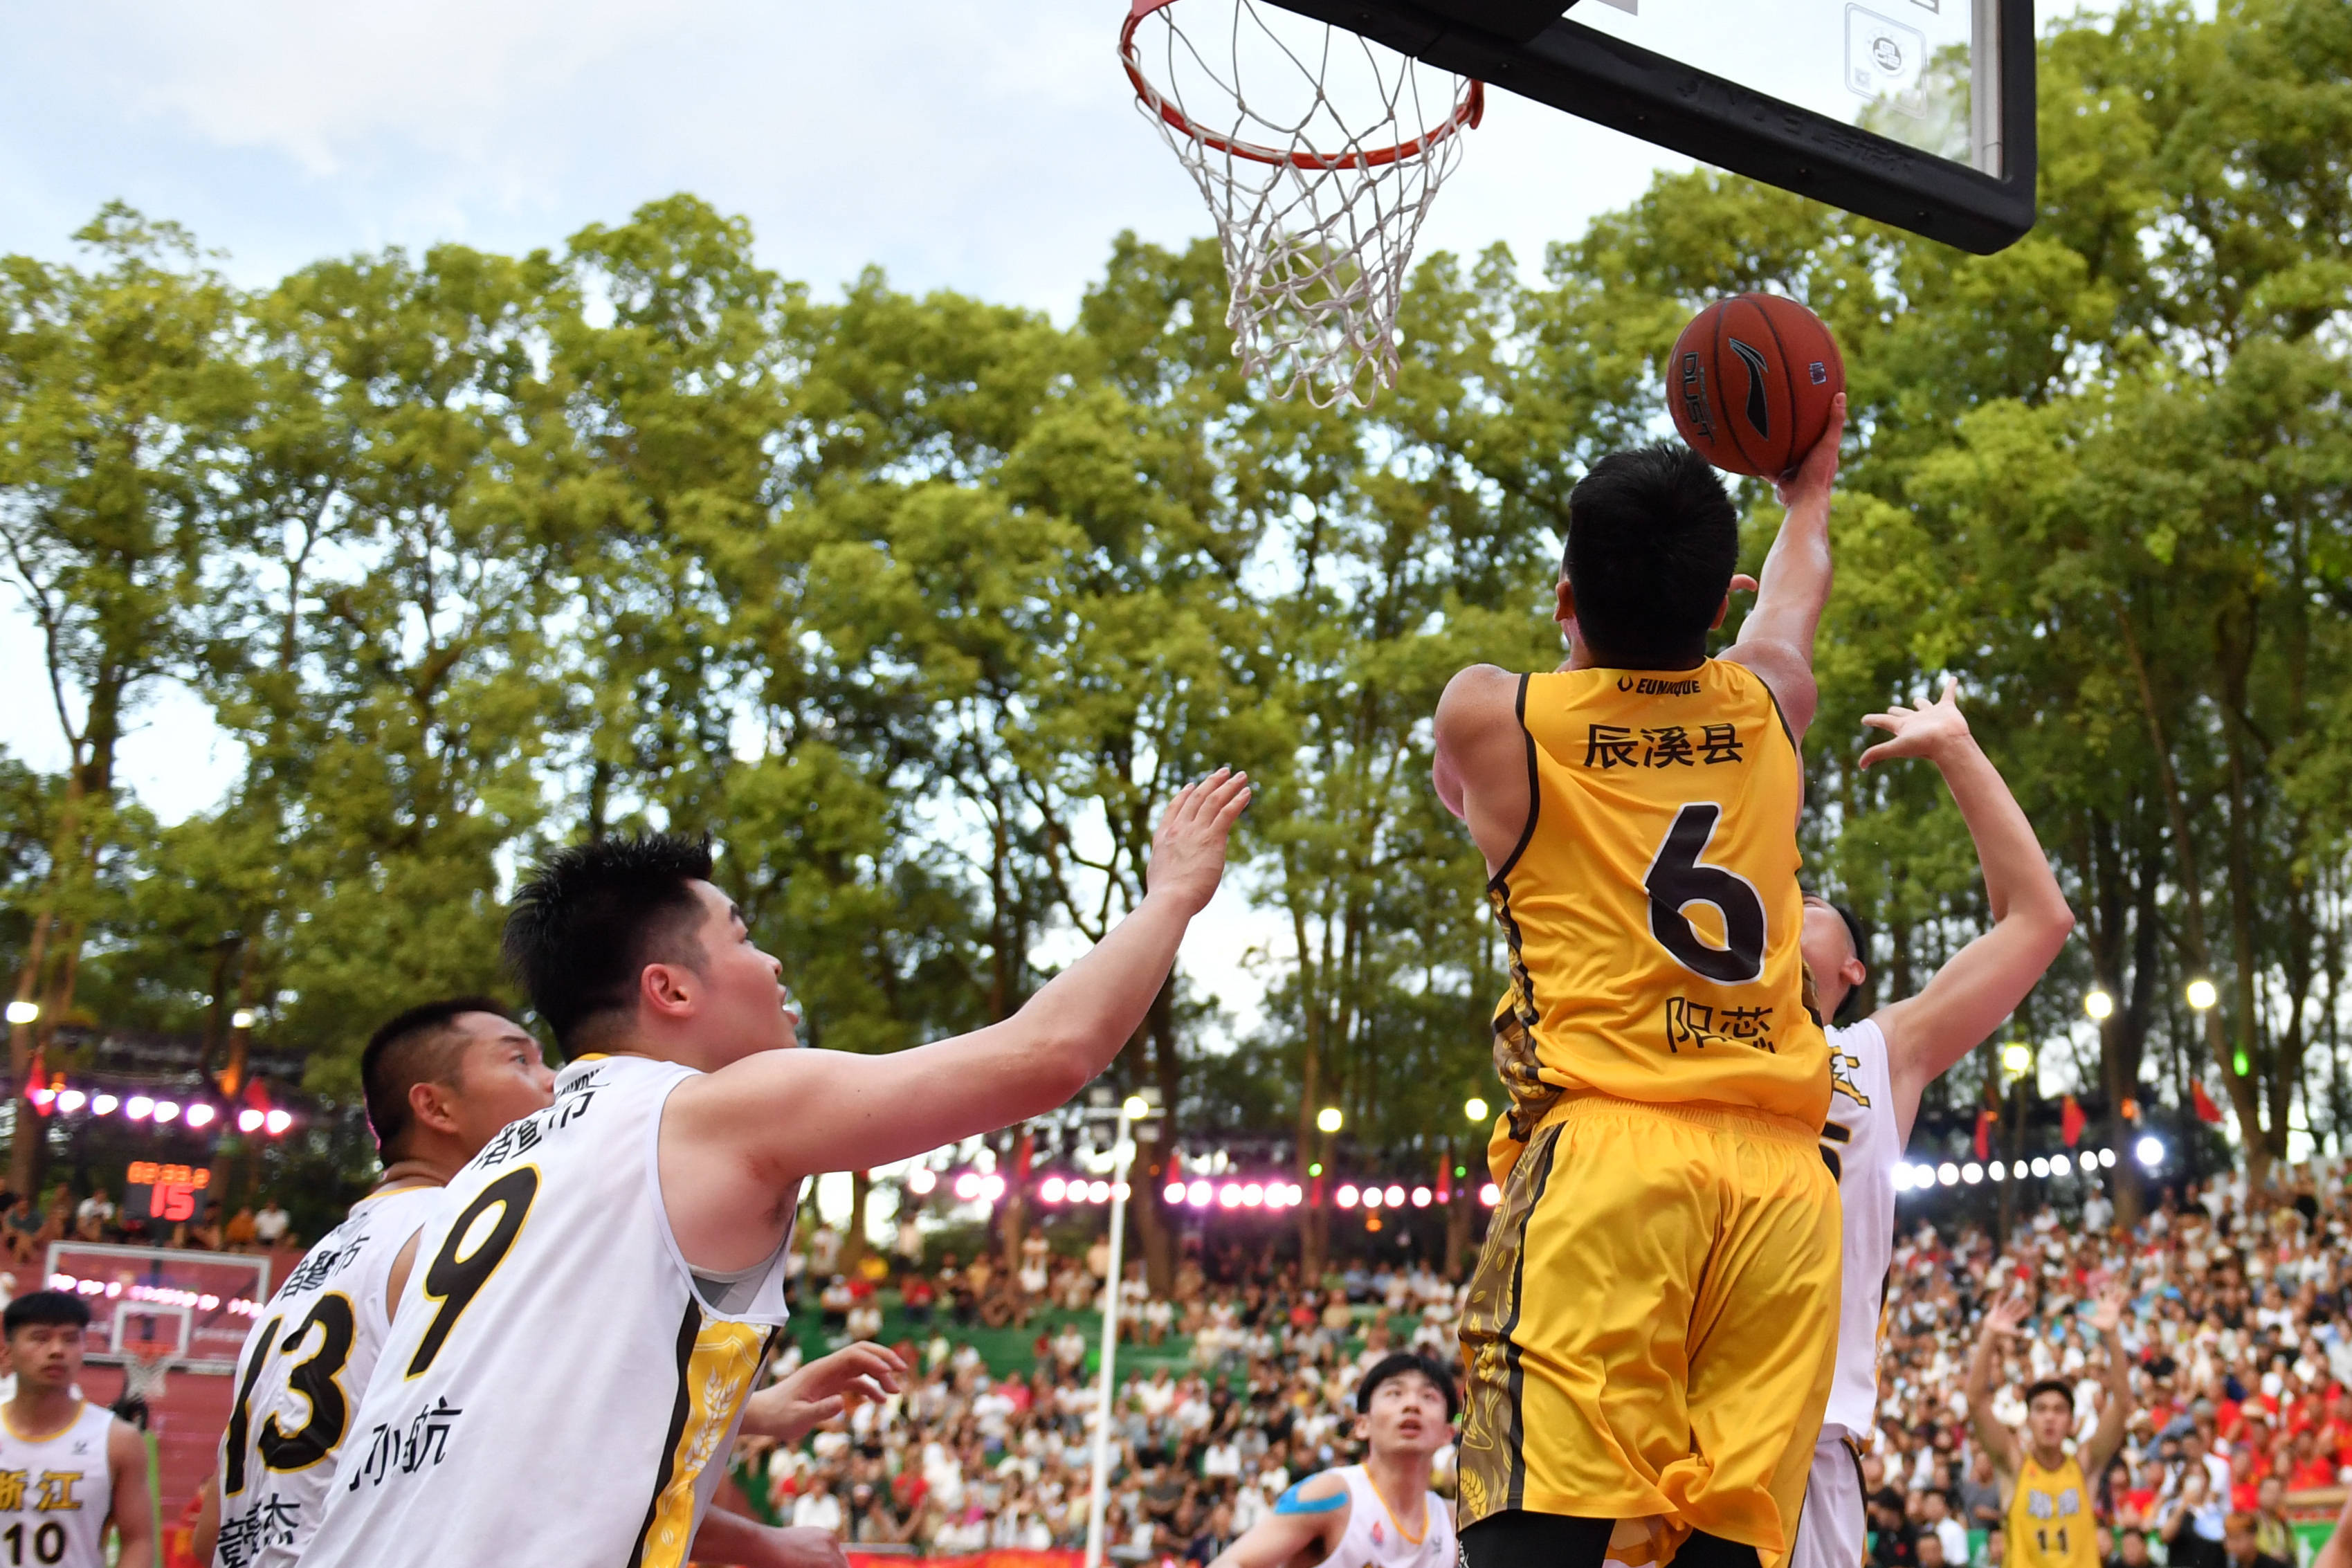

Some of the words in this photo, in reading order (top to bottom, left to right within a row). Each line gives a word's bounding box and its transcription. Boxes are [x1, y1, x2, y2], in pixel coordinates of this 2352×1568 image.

[1584, 723, 1743, 769] 辰溪县
[1643, 801, 1767, 985] 6
[150, 1181, 195, 1221] 15
[404, 1163, 541, 1381] 9
[226, 1291, 355, 1497] 13
[4, 1521, 66, 1565] 10
[2036, 1526, 2068, 1556] 11
